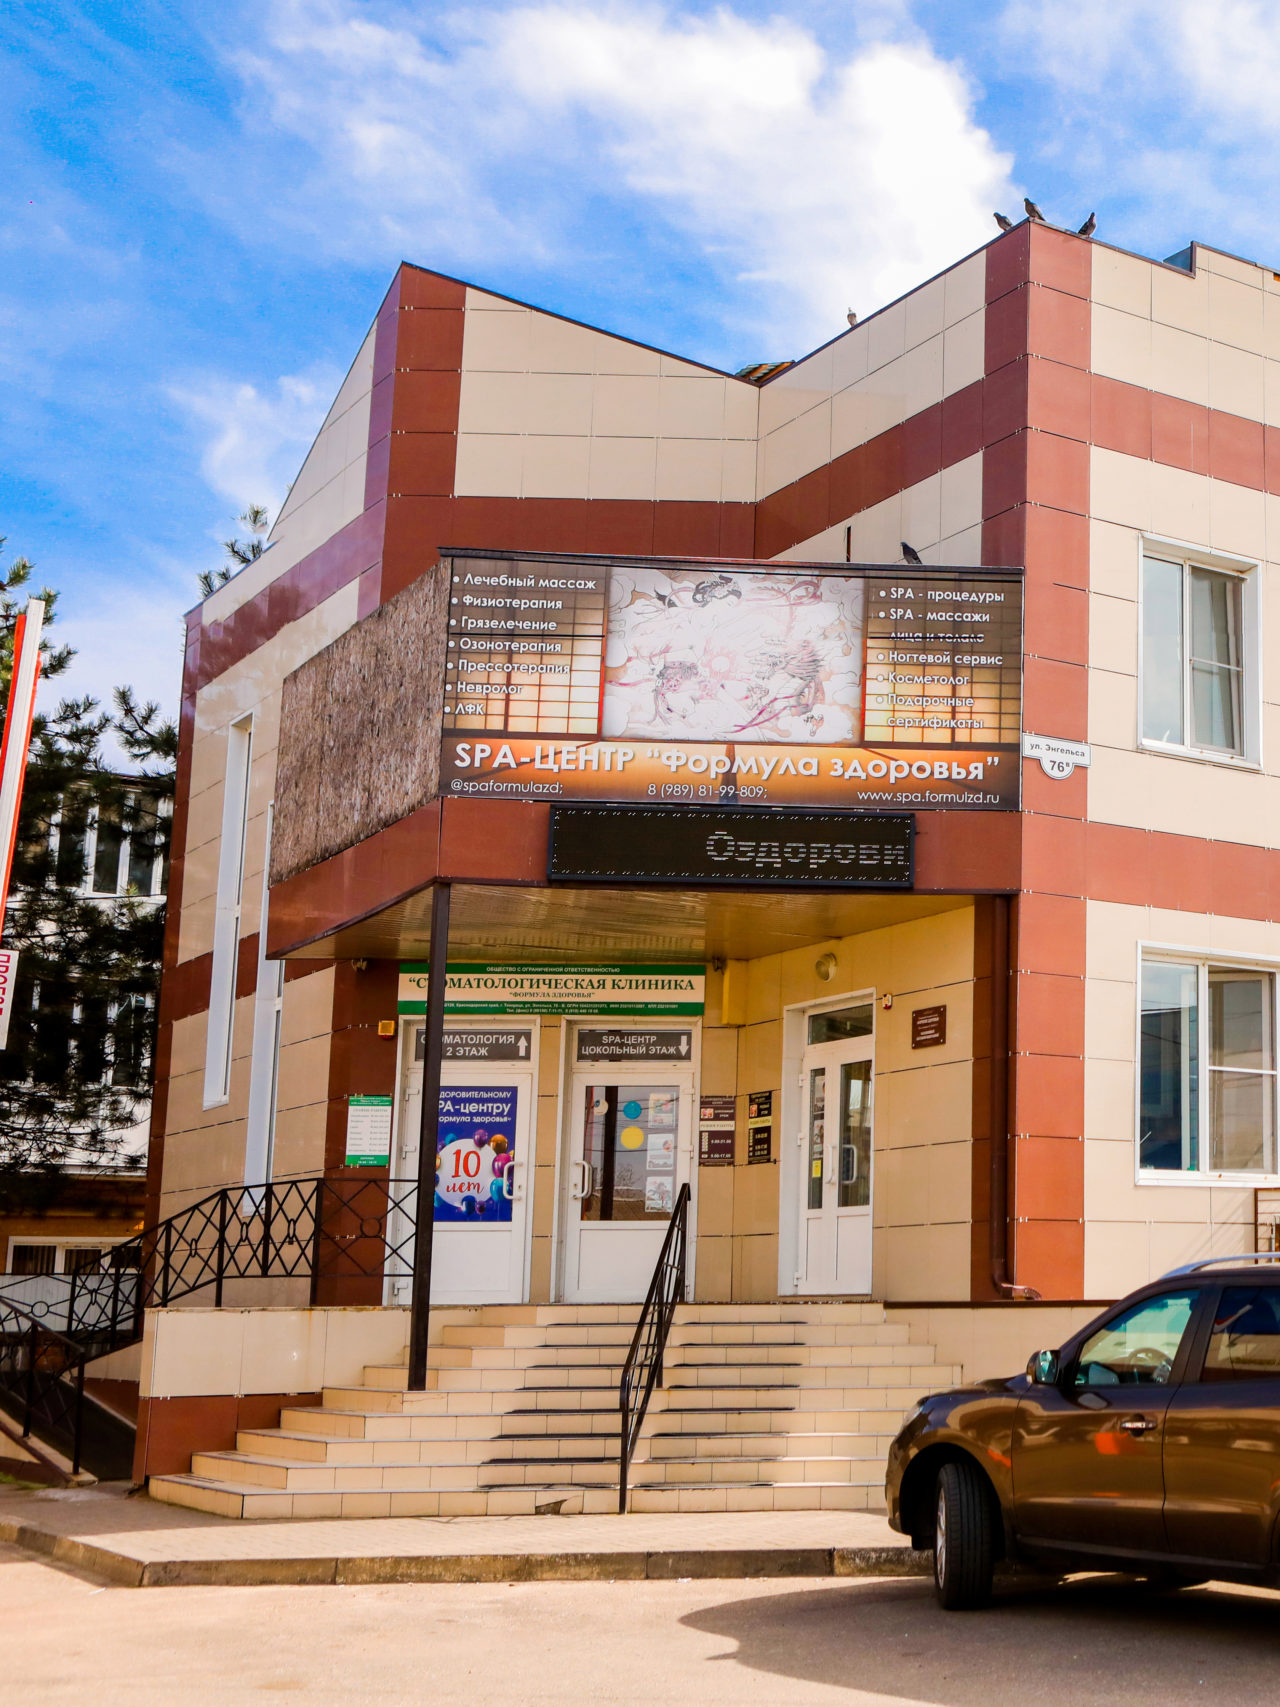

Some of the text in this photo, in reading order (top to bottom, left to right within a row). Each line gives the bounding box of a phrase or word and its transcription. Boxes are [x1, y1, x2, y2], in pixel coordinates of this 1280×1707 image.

[463, 573, 597, 590] Лечебный массаж
[462, 594, 563, 610] Физиотерапия
[890, 587, 914, 600] SPA
[927, 591, 1005, 603] процедуры
[889, 608, 914, 620] SPA
[926, 611, 990, 622] массажи
[461, 616, 557, 630] Грязелечение
[459, 637, 561, 653] Озонотерапия
[888, 650, 1003, 666] Ногтевой сервис
[458, 659, 570, 675] Прессотерапия
[888, 672, 970, 685] Косметолог
[456, 681, 524, 695] Невролог
[887, 693, 975, 708] Подарочные
[455, 703, 485, 715] ЛФК
[887, 716, 984, 729] сертификаты
[454, 742, 635, 773] SPA-ЦЕНТР
[1045, 744, 1085, 757] Энгельса
[450, 778, 564, 795] @spaformulazd;
[647, 783, 768, 799] 8 (989) 81-99-809;
[857, 789, 1000, 804] www.spa.formulzd.ru
[408, 977, 696, 991] “СМАТОЛОГИЧЕСКАЯ КЛИНИКА
[602, 1035, 657, 1045] SPA-ЦЕНТР
[446, 1047, 489, 1056] 2 ЭТАЖ
[582, 1045, 676, 1055] ЦОКОЛЬНЫЙ ЭТАЖ
[438, 1100, 512, 1115] PA-центру
[451, 1149, 481, 1178] 10
